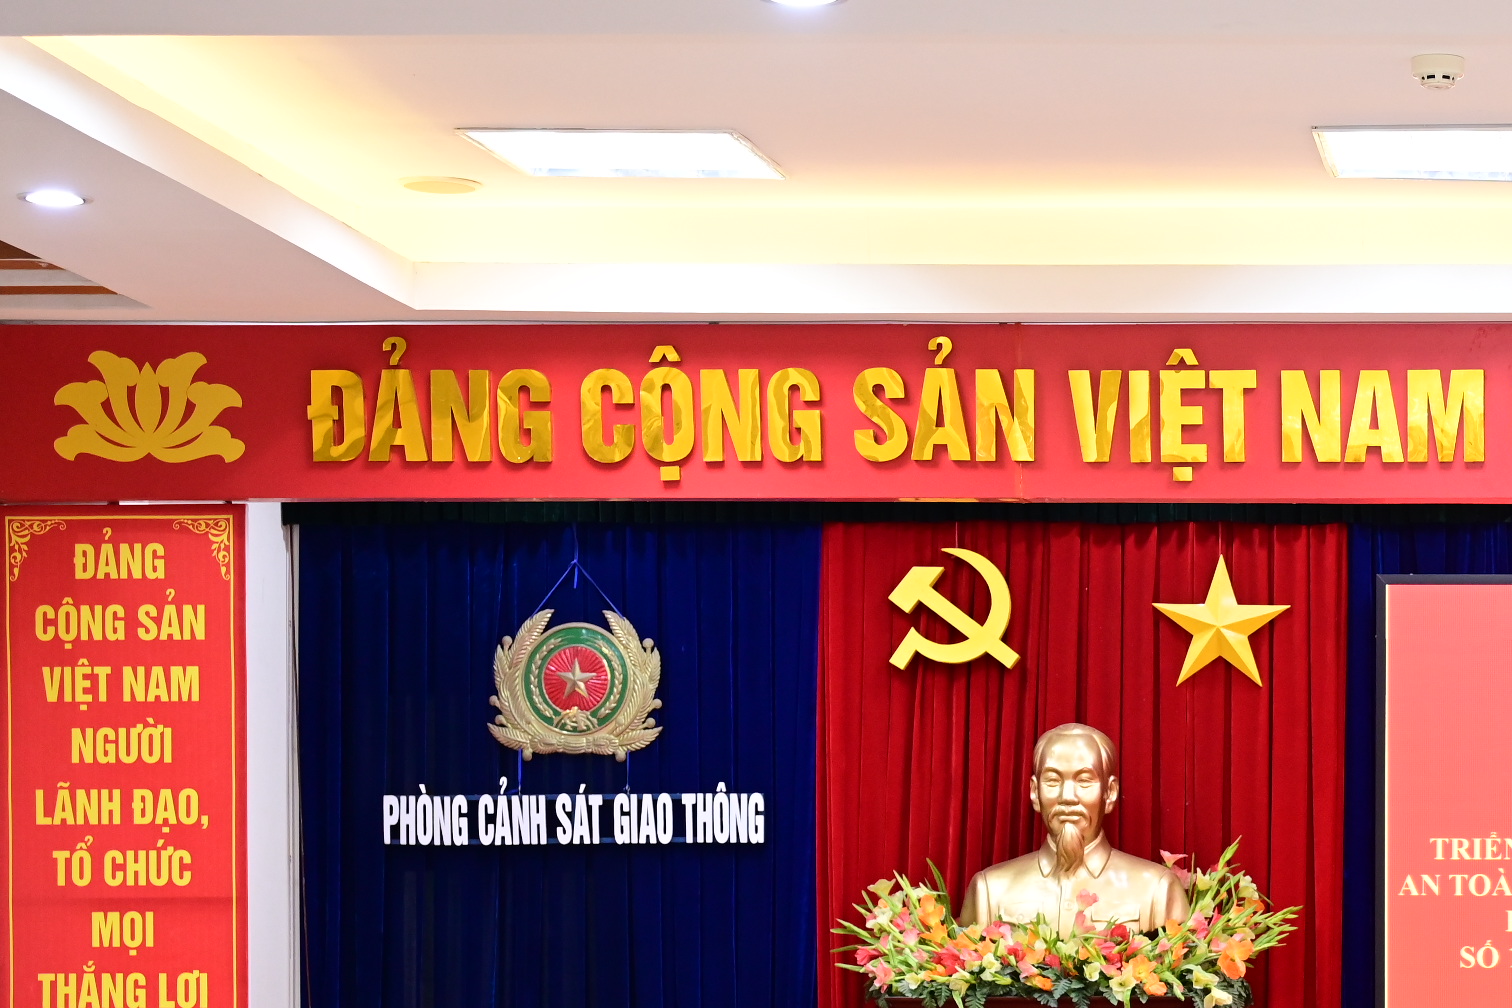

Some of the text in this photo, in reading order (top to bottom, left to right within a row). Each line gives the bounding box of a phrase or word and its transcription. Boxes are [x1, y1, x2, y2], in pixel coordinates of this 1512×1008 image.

[307, 337, 553, 463] ĐẢNG
[581, 346, 821, 480] CỘNG
[853, 336, 1034, 462] SẢN
[1068, 349, 1257, 481] VIỆT
[1281, 369, 1486, 462] NAM
[74, 528, 165, 579] ĐẢNG
[36, 589, 205, 649] CỘNG SẢN
[42, 659, 199, 710] VIỆT NAM
[72, 718, 172, 763] NGƯỜI
[36, 782, 208, 833] LÃNH ĐẠO,
[383, 777, 764, 846] PHÒNG CẢNH SÁT GIAO THÔNG
[53, 827, 191, 886] TỔ CHỨC
[1398, 875, 1440, 895] AN
[92, 911, 153, 955] MỌI
[1460, 940, 1499, 968] SỐ
[38, 961, 146, 1008] THẮNG
